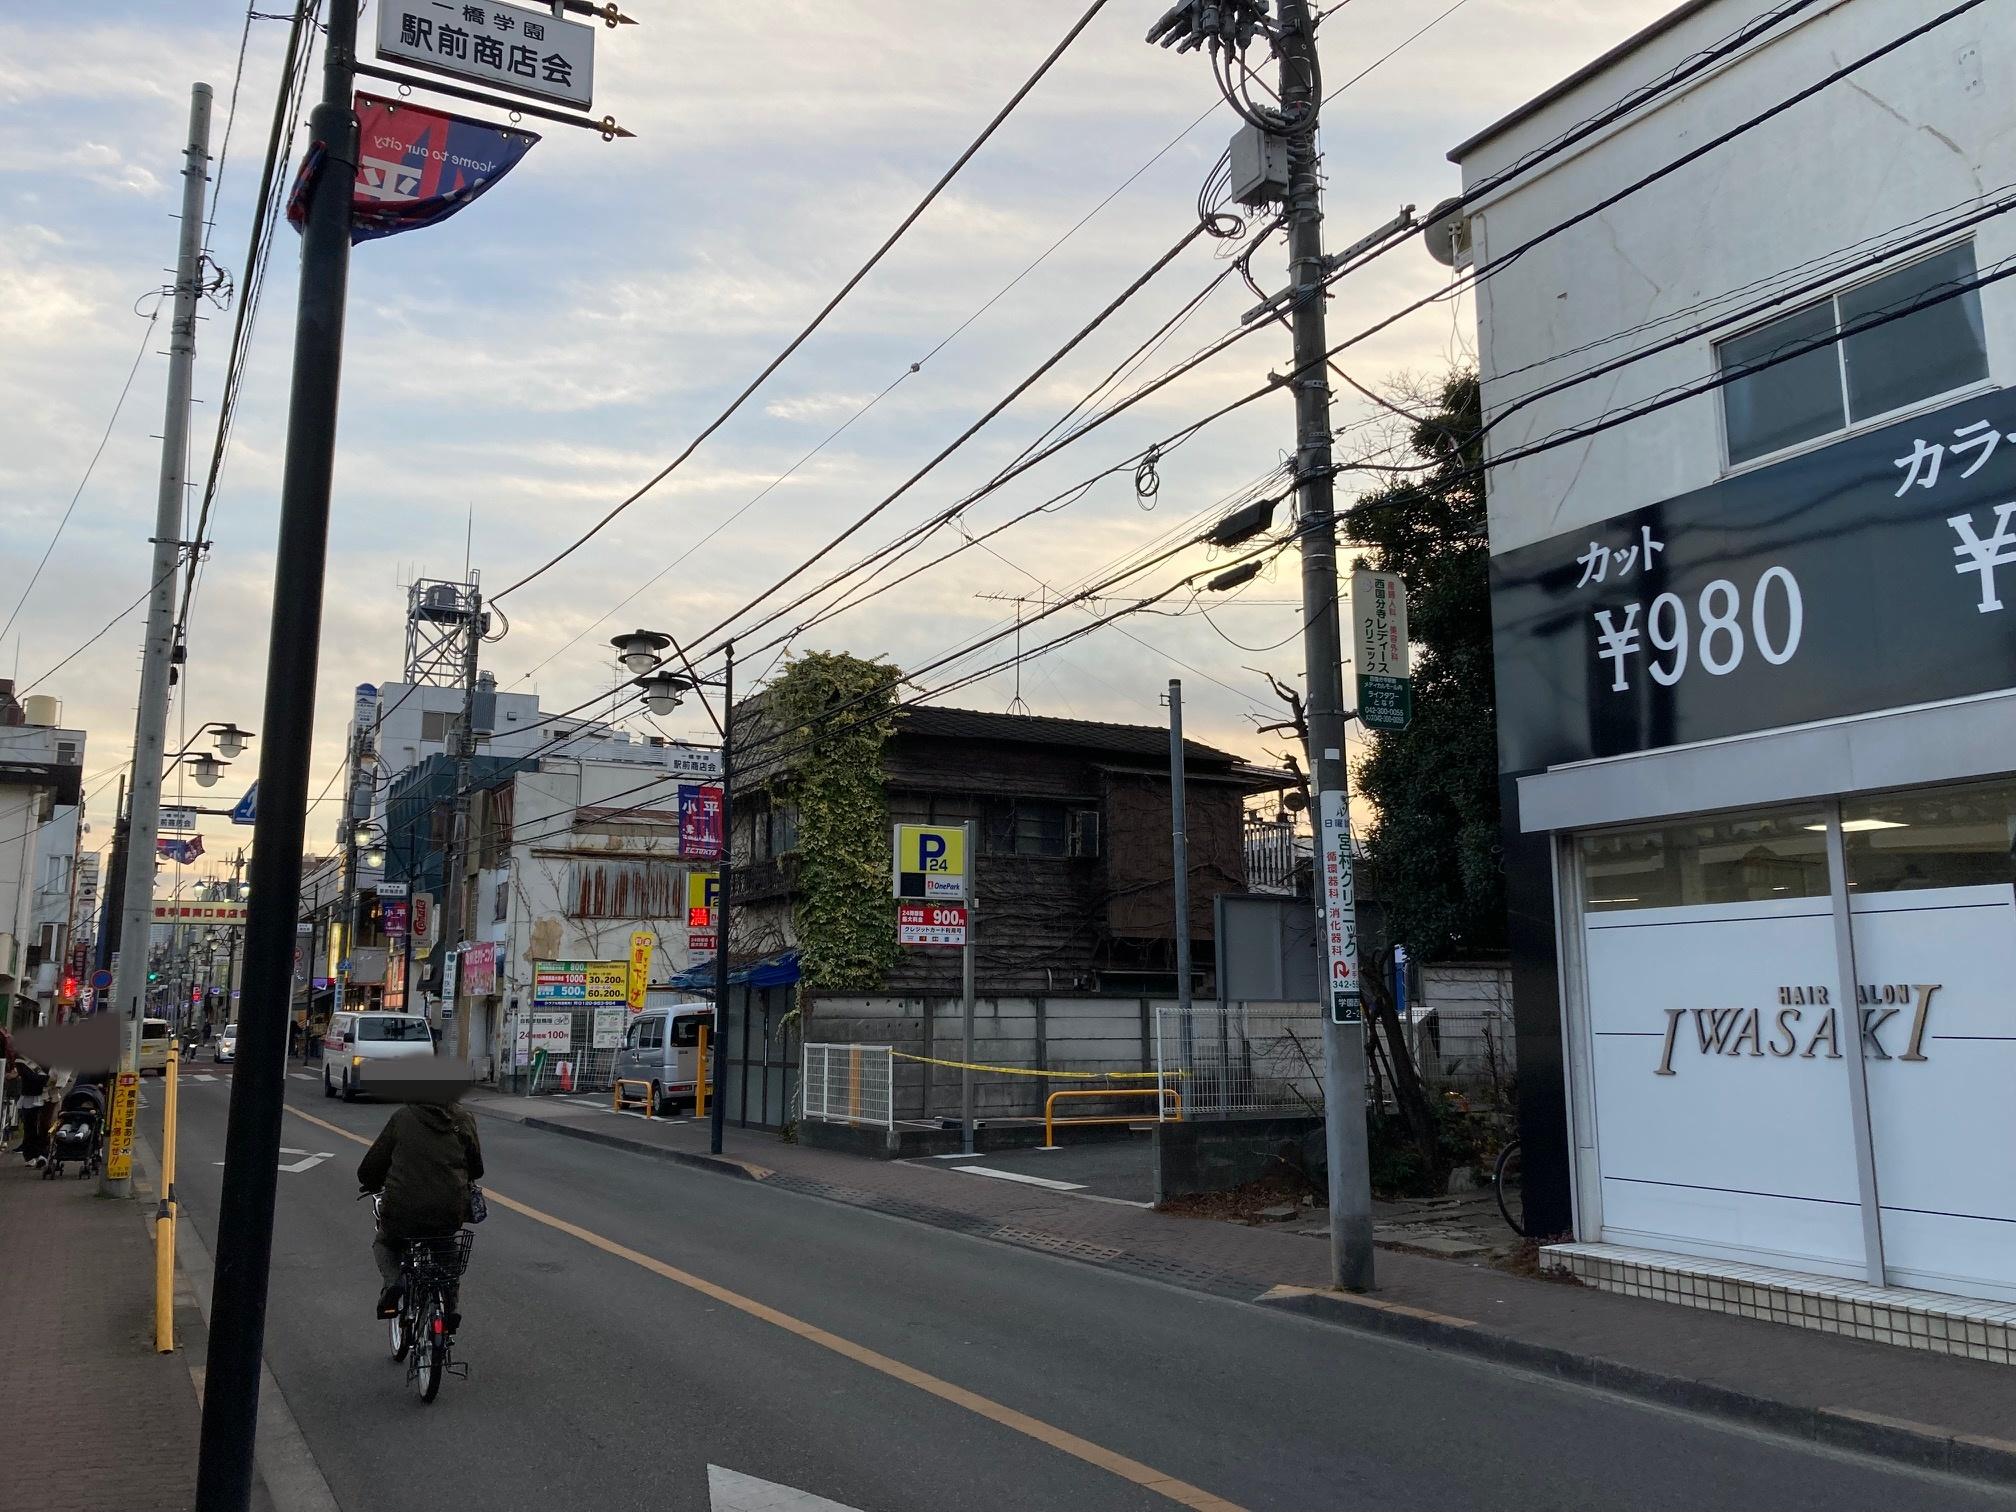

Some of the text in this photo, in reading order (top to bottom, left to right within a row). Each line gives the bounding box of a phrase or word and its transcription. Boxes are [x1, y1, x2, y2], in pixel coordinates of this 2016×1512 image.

[432, 1, 544, 41] 一橋学園
[400, 12, 572, 88] 駅前商店会
[1576, 525, 1665, 589] カット
[1364, 617, 1376, 673] クリニック
[1375, 578, 1390, 674] 西国分寺レディース
[1594, 565, 1803, 692] ¥980
[1368, 690, 1400, 700] ライフタワー
[1373, 699, 1395, 707] となり
[673, 759, 717, 772] 駅前商店会
[682, 800, 720, 816] 小平
[919, 833, 946, 871] P
[929, 859, 948, 872] 24
[934, 882, 960, 890] OnePark
[1326, 851, 1342, 957] 循環器科・消化器科
[1338, 832, 1357, 958] 宮村クリニック
[690, 908, 708, 926] 満
[905, 926, 962, 934] クレジットカード利用可
[933, 909, 965, 926] 900円
[1778, 984, 1910, 1005] HAIR ALON
[1653, 984, 1942, 1076] IWASAKI
[123, 1090, 137, 1147] 横断歩道あり
